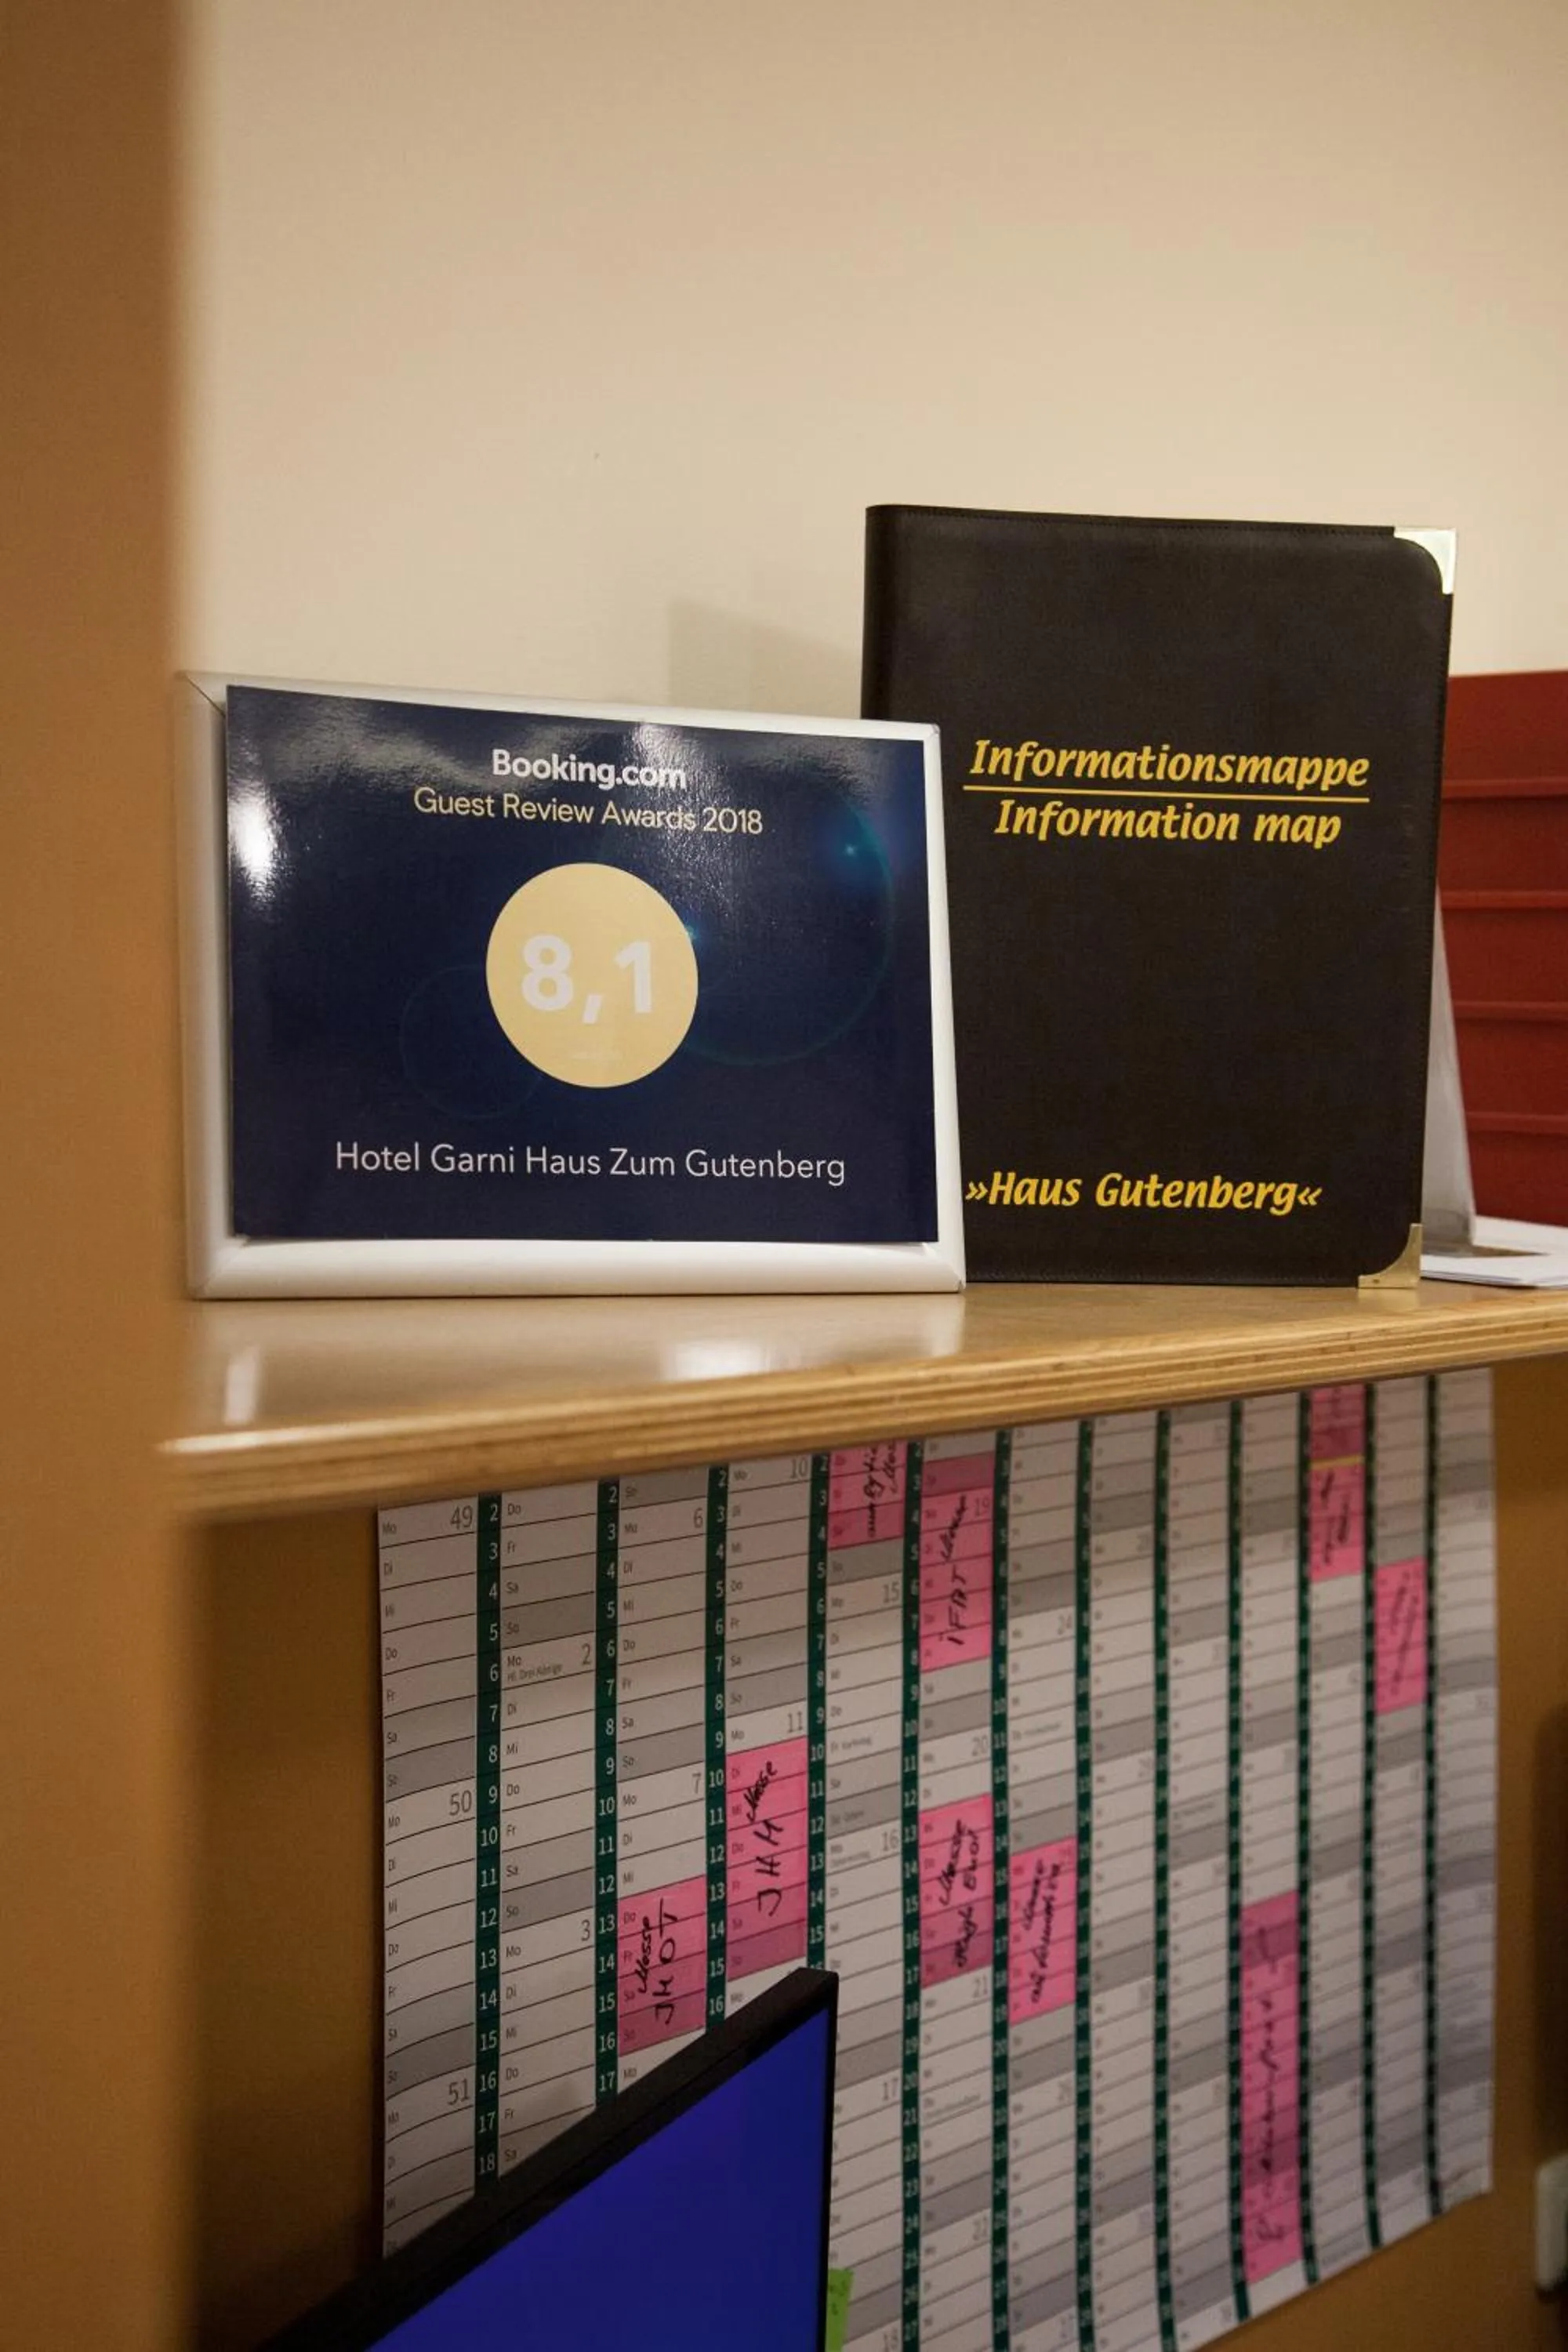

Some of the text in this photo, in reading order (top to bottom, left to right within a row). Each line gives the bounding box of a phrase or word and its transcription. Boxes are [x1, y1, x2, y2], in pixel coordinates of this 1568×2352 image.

[492, 748, 688, 790] Booking.com
[969, 740, 1370, 791] Informationsmappe
[413, 786, 764, 835] Guest Review Awards 2018
[995, 800, 1342, 850] Information map
[520, 934, 653, 1025] 8,1
[336, 1142, 846, 1187] Hotel Garni Haus Zum Gutenberg
[966, 1171, 1323, 1216] »Haus Gutenberg«
[789, 1457, 808, 1479] 10
[717, 1470, 728, 1488] 2
[608, 1486, 617, 1504] 2
[450, 1504, 474, 1530] 49
[489, 1503, 499, 1522] 2
[693, 1507, 703, 1529] 6
[717, 1505, 725, 1523] 3
[608, 1523, 616, 1541] 3
[488, 1542, 499, 1560] 3
[716, 1543, 724, 1559] 4
[606, 1562, 615, 1579] 4
[488, 1582, 498, 1599] 4
[716, 1580, 724, 1598] 5
[607, 1600, 615, 1619] 5
[489, 1622, 499, 1642] 5
[715, 1617, 724, 1635] 6
[582, 1643, 591, 1666] 2
[606, 1639, 615, 1657] 6
[489, 1664, 499, 1682] 6
[715, 1655, 724, 1672] 7
[606, 1679, 615, 1697] 7
[714, 1693, 724, 1711] 8
[489, 1704, 499, 1722] 7
[787, 1711, 804, 1733] 11
[605, 1718, 615, 1736] 8
[715, 1730, 724, 1748] 9
[488, 1744, 498, 1763] 8
[605, 1757, 615, 1775] 9
[691, 1772, 702, 1795] 7
[709, 1769, 725, 1788] 10
[448, 1790, 473, 1817] 50
[488, 1785, 499, 1804] 9
[599, 1796, 615, 1817] 10
[710, 1806, 724, 1826] 11
[481, 1827, 499, 1847] 10
[598, 1836, 615, 1856] 11
[710, 1845, 725, 1864] 12
[481, 1868, 498, 1888] 11
[598, 1875, 615, 1895] 12
[710, 1882, 726, 1902] 13
[480, 1907, 498, 1928] 12
[599, 1914, 617, 1934] 13
[581, 1918, 591, 1942] 3
[710, 1920, 725, 1940] 14
[480, 1948, 497, 1969] 13
[598, 1953, 615, 1973] 14
[710, 1958, 725, 1977] 15
[480, 1989, 498, 2009] 14
[599, 1992, 615, 2012] 15
[710, 1995, 724, 2015] 16
[480, 2030, 498, 2051] 15
[600, 2032, 615, 2051] 16
[479, 2071, 497, 2092] 16
[599, 2071, 615, 2092] 17
[447, 2078, 470, 2106] 51
[478, 2112, 496, 2134] 17
[479, 2153, 495, 2174] 18
